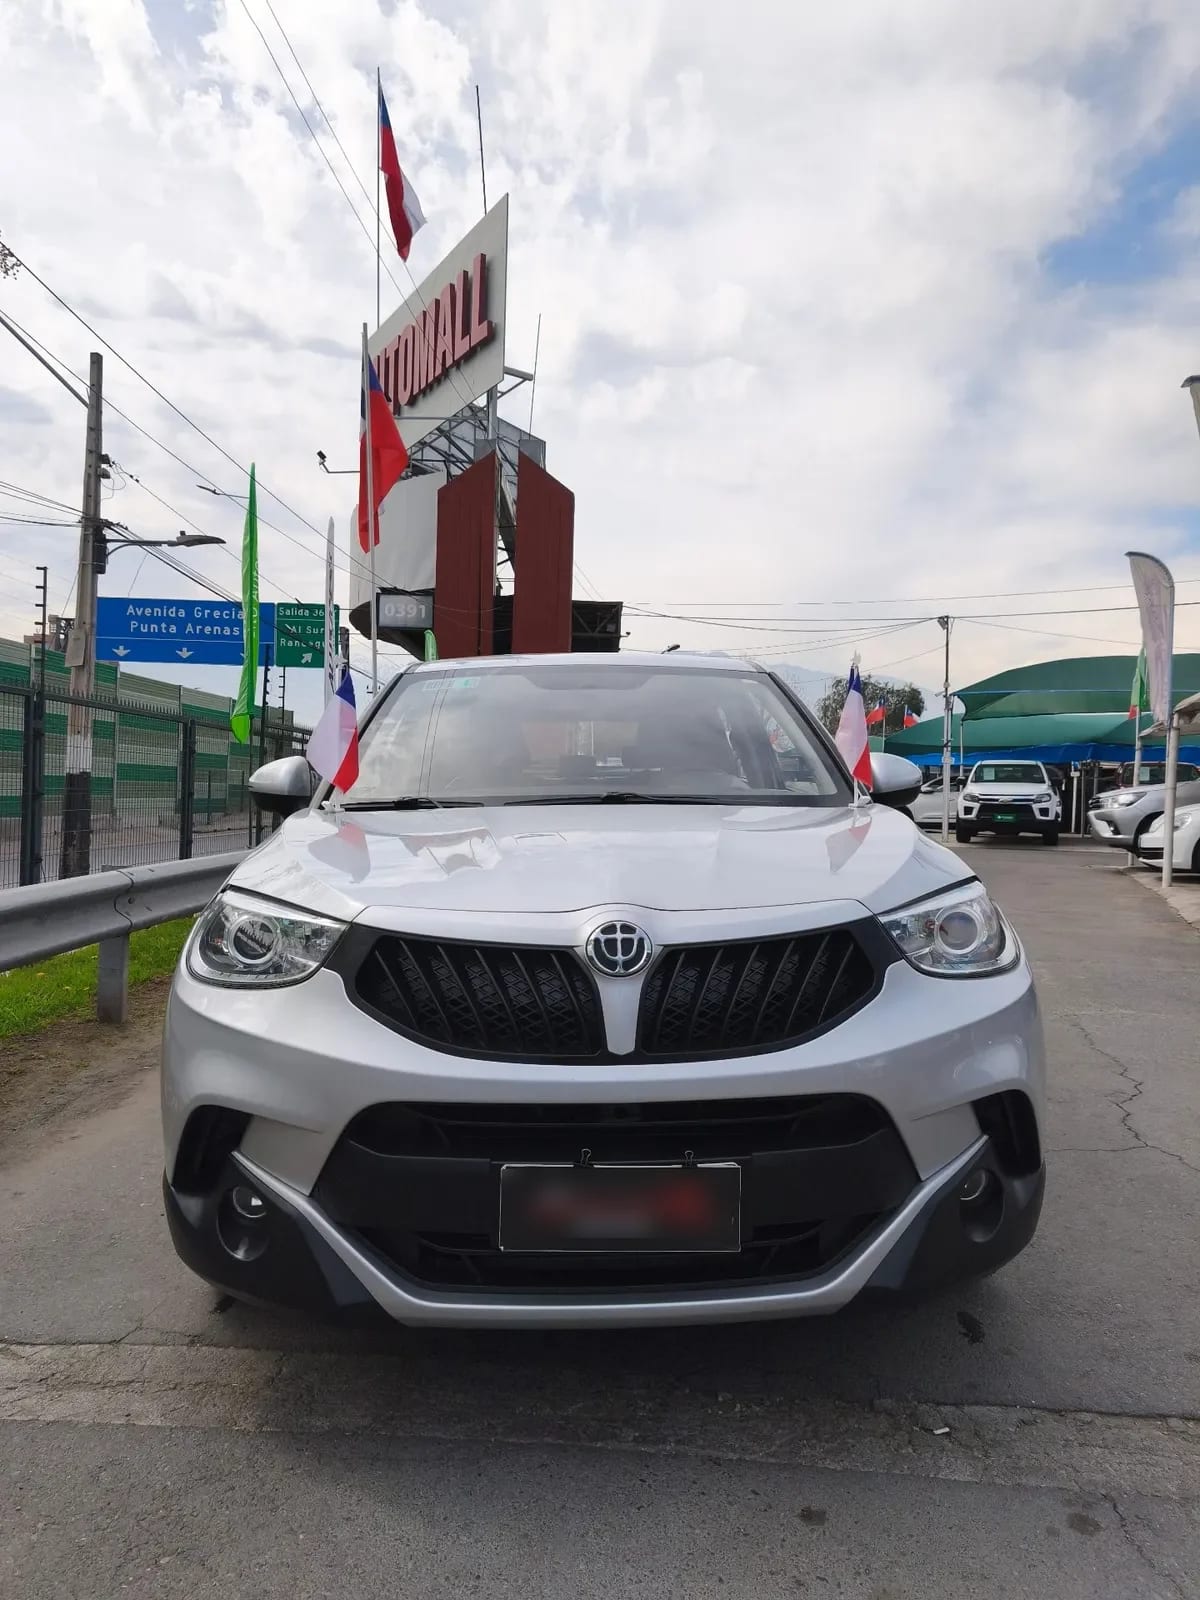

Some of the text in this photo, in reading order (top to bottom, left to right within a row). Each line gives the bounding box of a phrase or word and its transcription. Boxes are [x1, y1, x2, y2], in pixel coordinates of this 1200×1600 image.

[373, 252, 493, 415] TOMALL
[126, 604, 245, 620] Avenida Grecia
[279, 607, 310, 617] Salida
[384, 603, 426, 618] 0391
[130, 621, 240, 636] Punta Arenas
[306, 625, 325, 634] Sur
